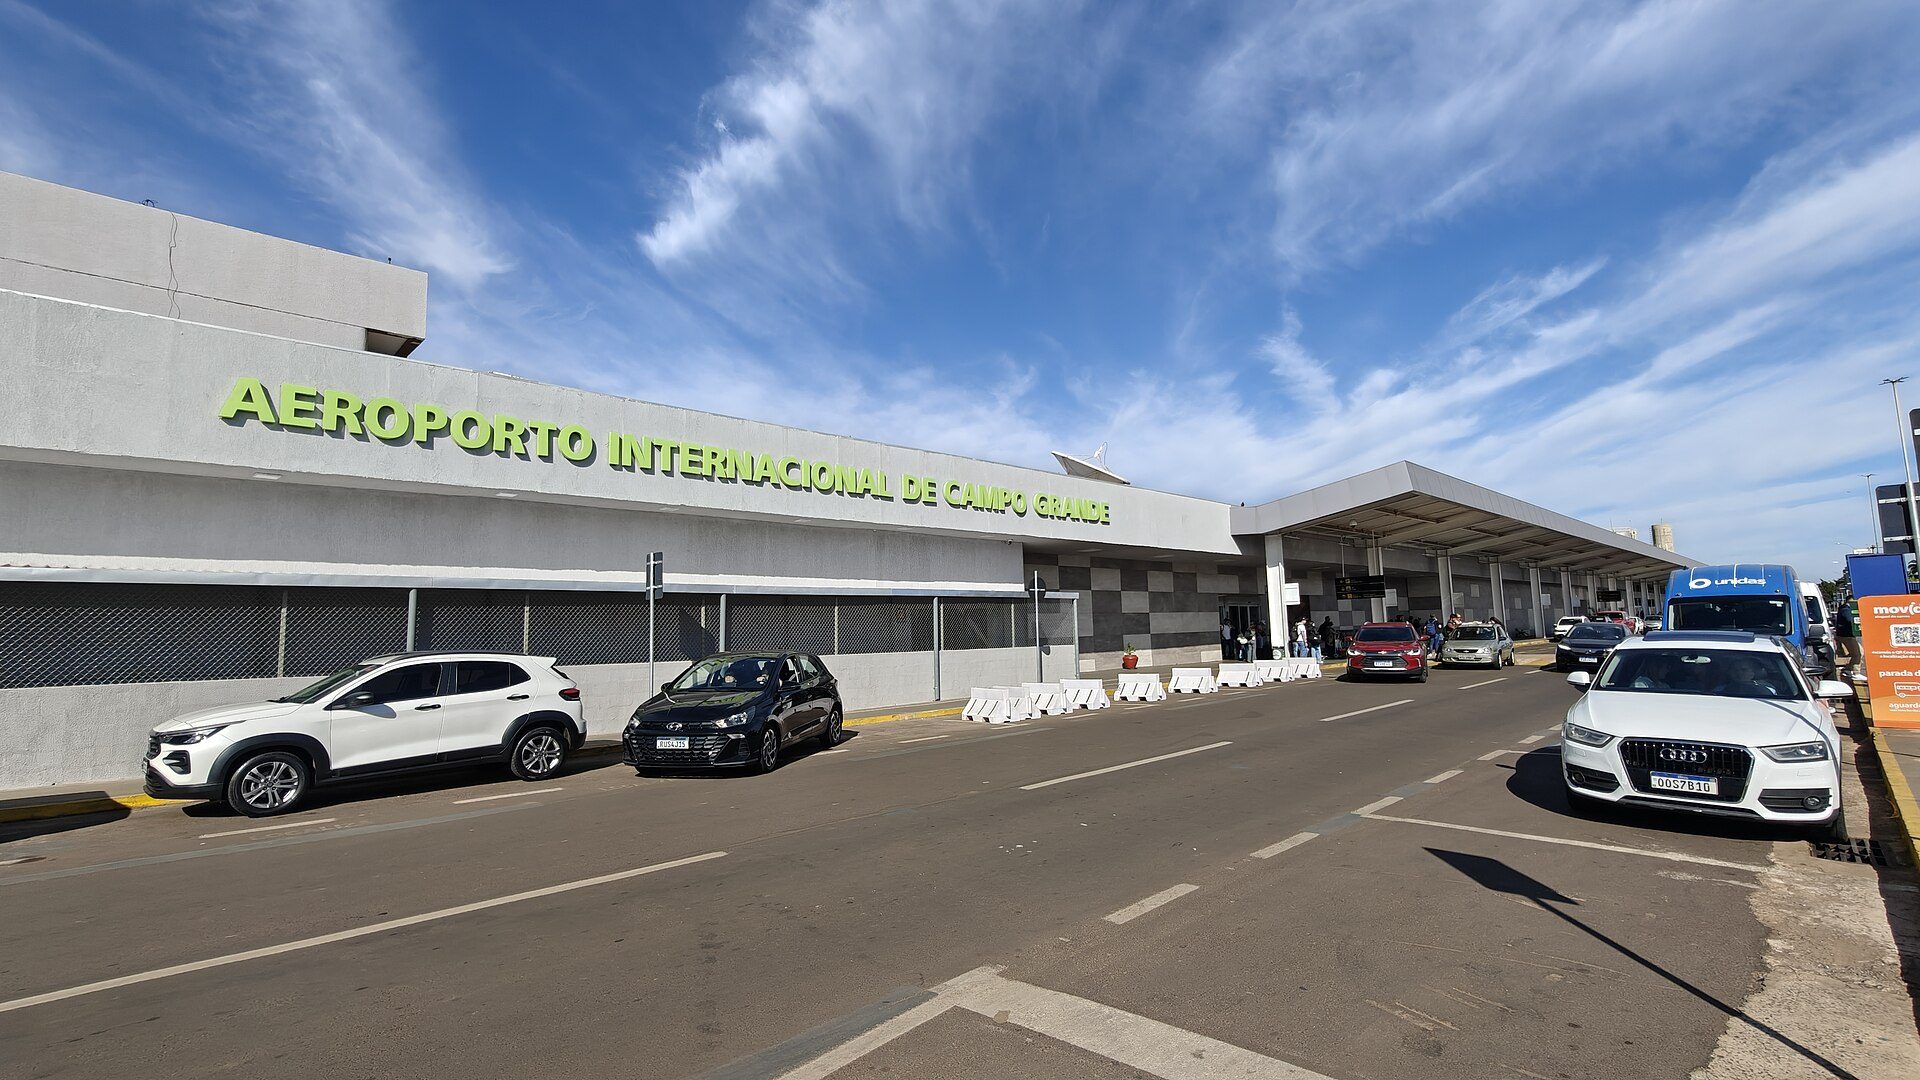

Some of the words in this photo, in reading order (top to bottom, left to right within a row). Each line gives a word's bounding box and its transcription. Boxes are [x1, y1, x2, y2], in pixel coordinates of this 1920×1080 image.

[218, 377, 594, 462] AEROPORTO
[608, 431, 894, 498] INTERNACIONAL
[902, 473, 937, 503] DE
[943, 480, 1027, 515] CAMPO
[1033, 492, 1111, 523] GRANDE
[1714, 577, 1766, 585] unidas
[1879, 670, 1914, 679] parada
[1889, 702, 1920, 710] aguard
